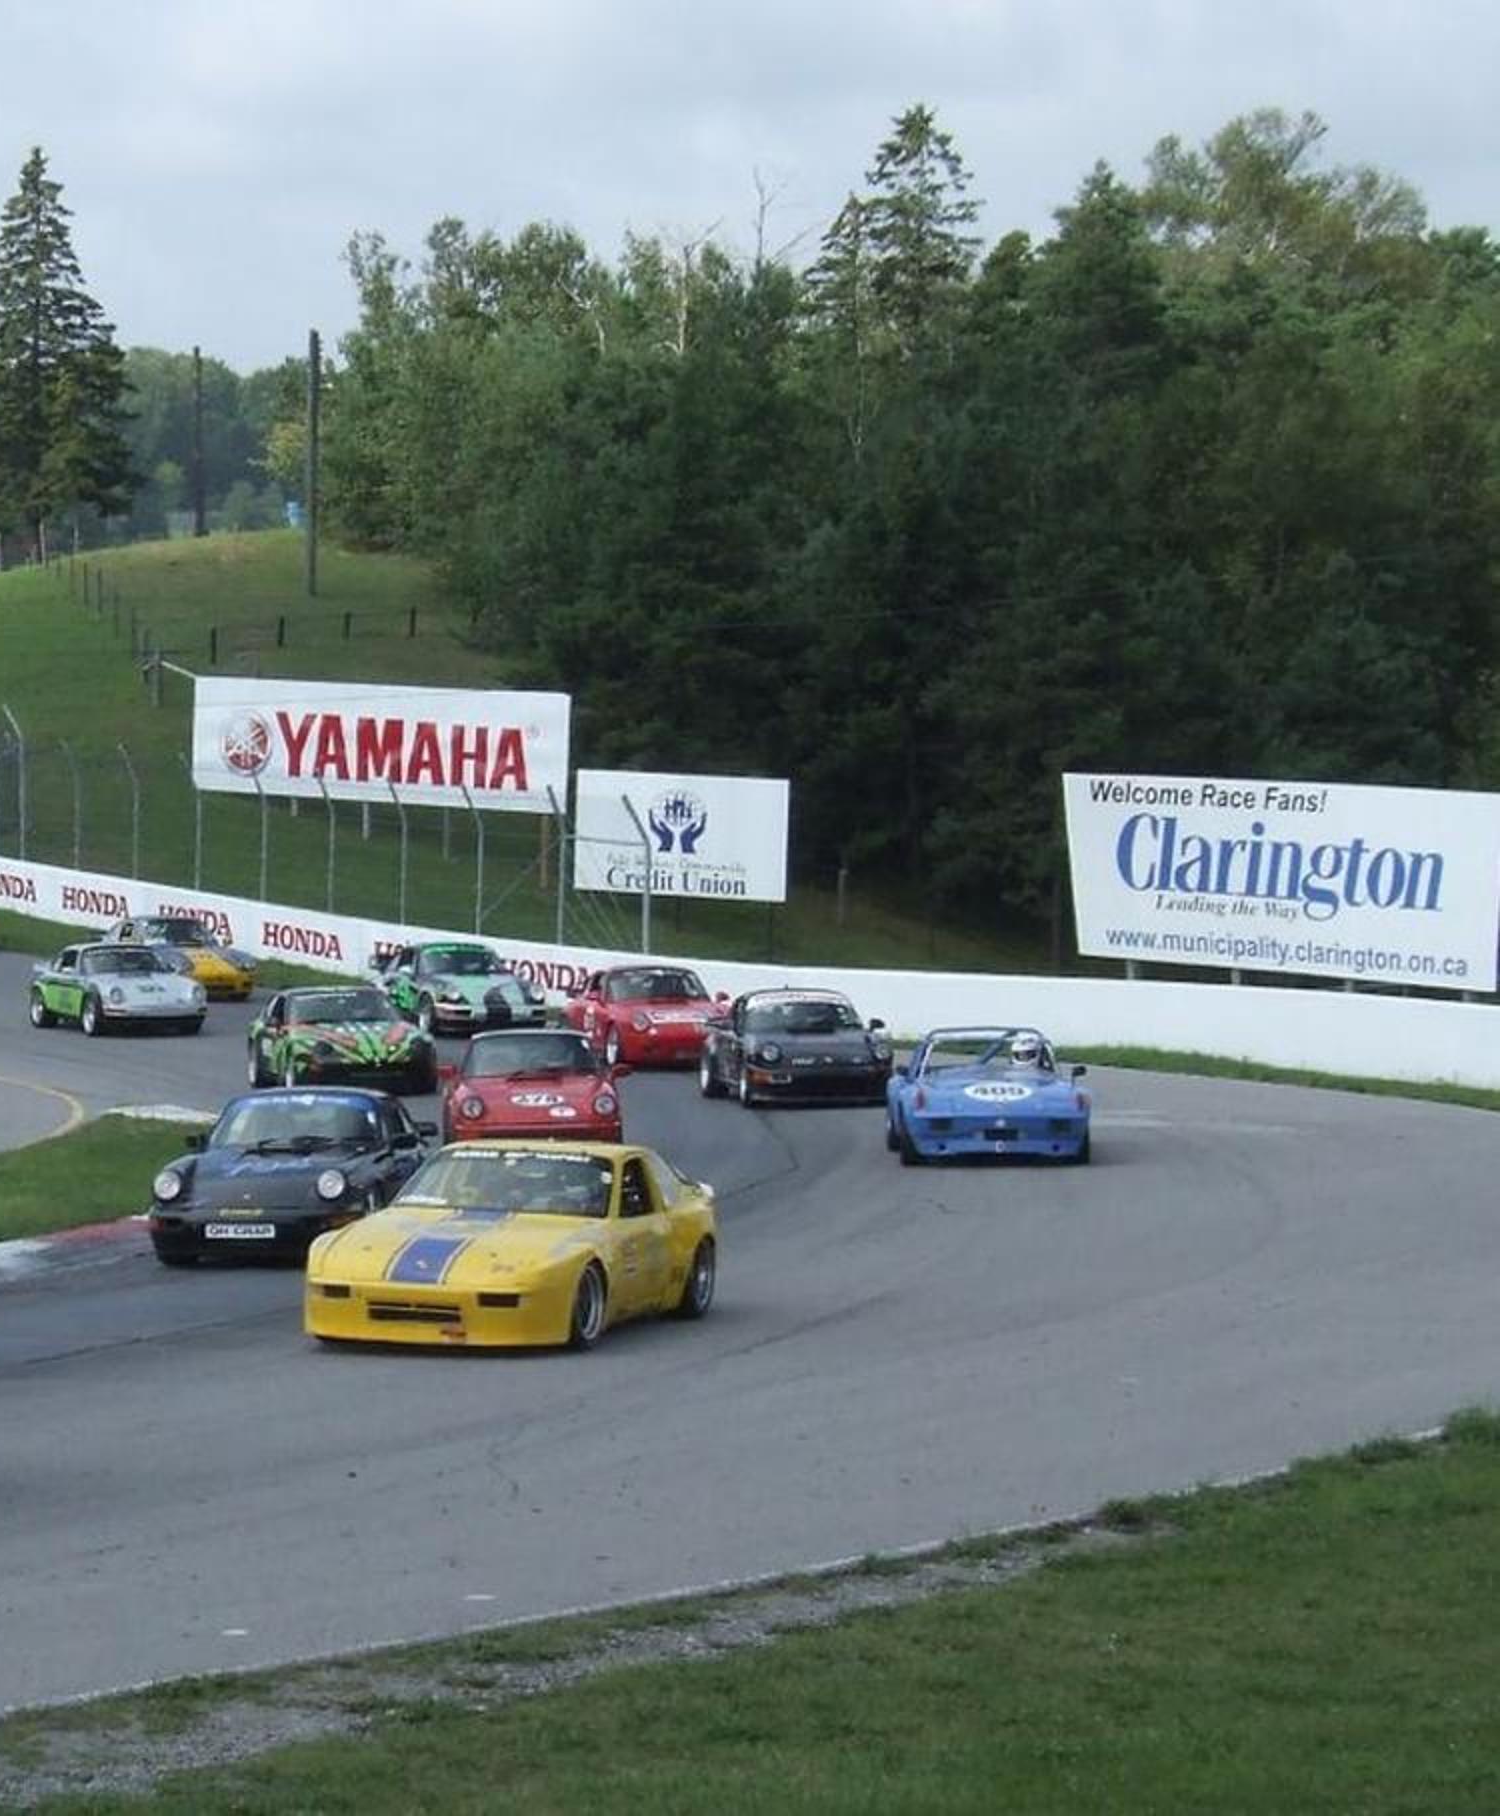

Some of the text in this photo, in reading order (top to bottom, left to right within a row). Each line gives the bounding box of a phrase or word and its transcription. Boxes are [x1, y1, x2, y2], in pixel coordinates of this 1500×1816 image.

[276, 711, 529, 792] YAMAHA
[1090, 780, 1328, 814] Welcome Race Fans!
[606, 866, 746, 895] Credit Union
[1116, 813, 1443, 921] Clarington
[62, 886, 131, 919] HONDA
[1155, 894, 1299, 923] Leading the Way
[261, 921, 343, 961] HONDA
[1106, 928, 1468, 977] www.municipality.clarington.on.ca
